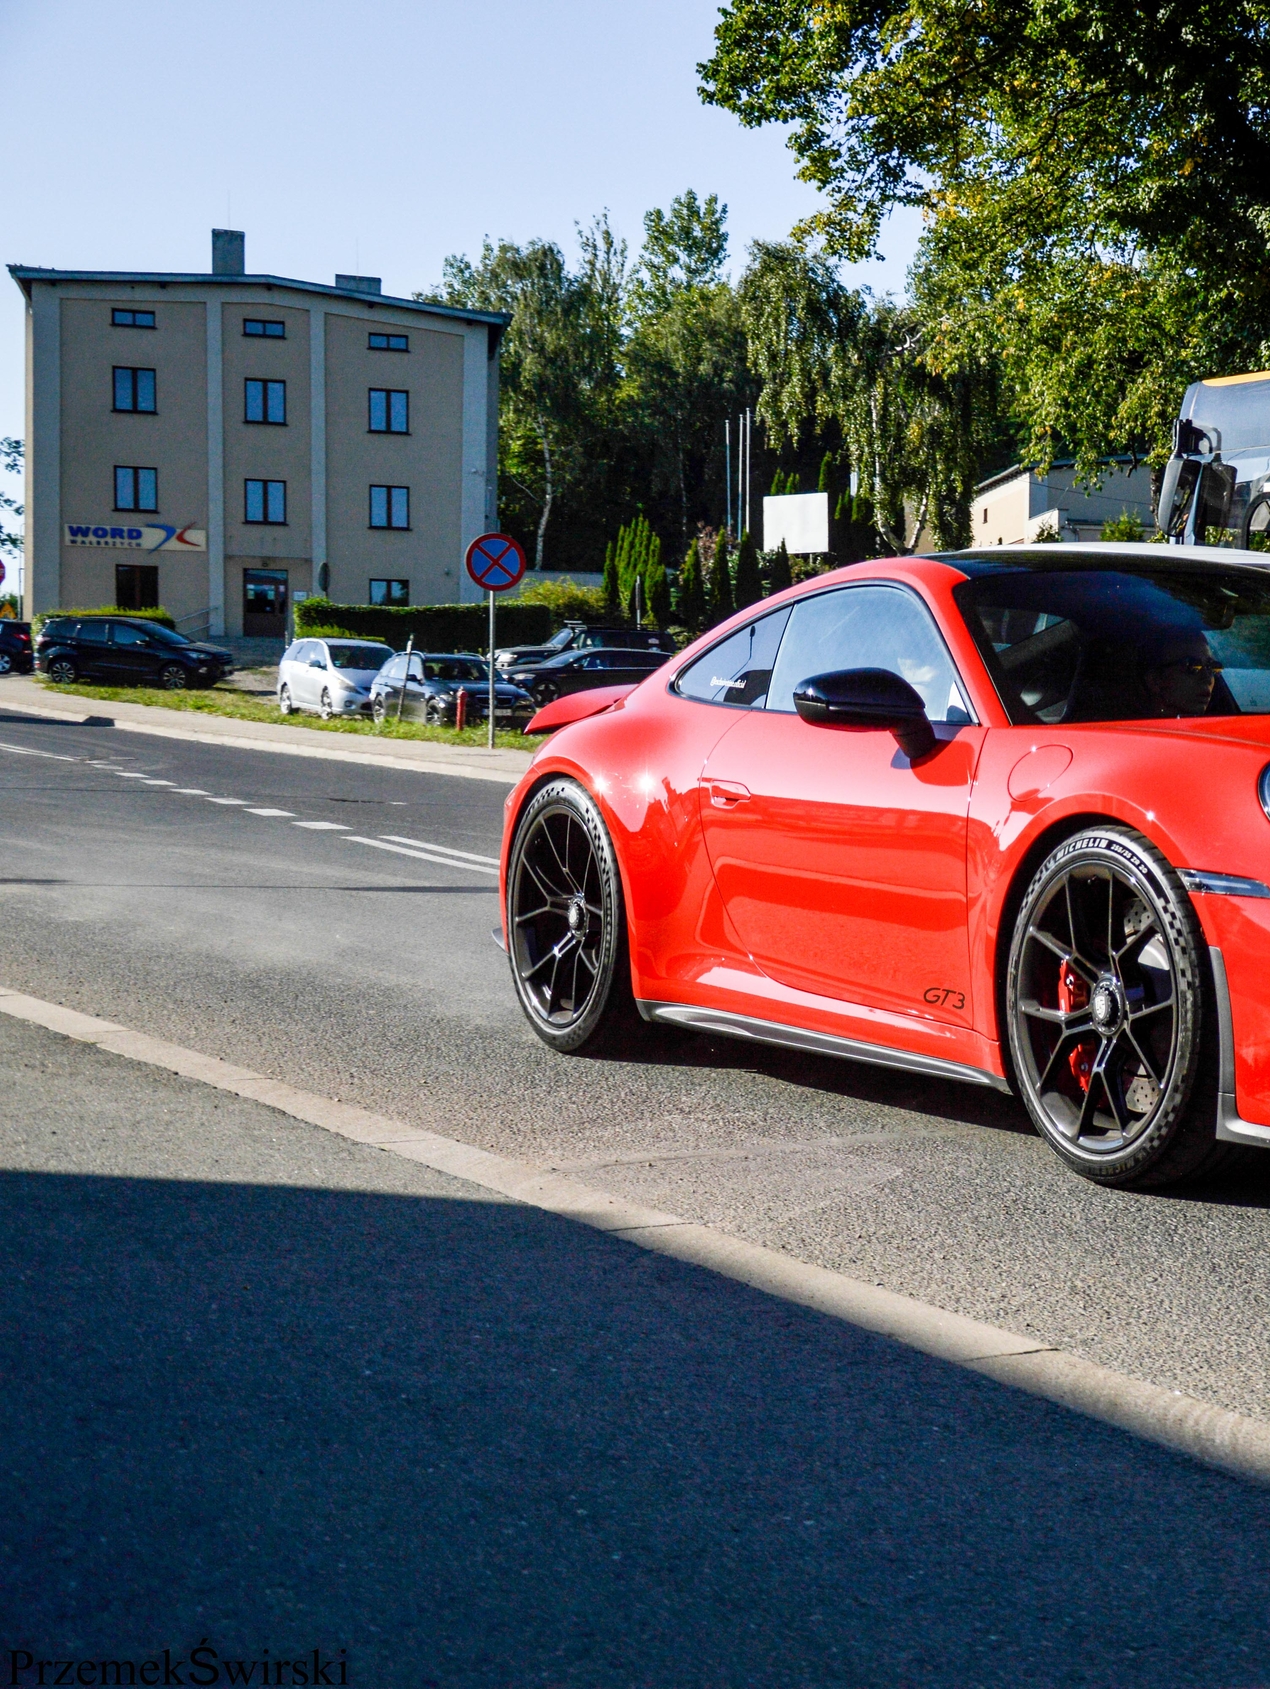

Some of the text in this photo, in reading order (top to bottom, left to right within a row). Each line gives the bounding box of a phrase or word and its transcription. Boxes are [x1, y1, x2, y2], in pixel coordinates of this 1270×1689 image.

[68, 525, 142, 540] WORD
[1056, 838, 1109, 861] MICHELIN
[1130, 856, 1141, 866] ZR
[1138, 864, 1149, 874] 20
[923, 987, 966, 1010] GT3
